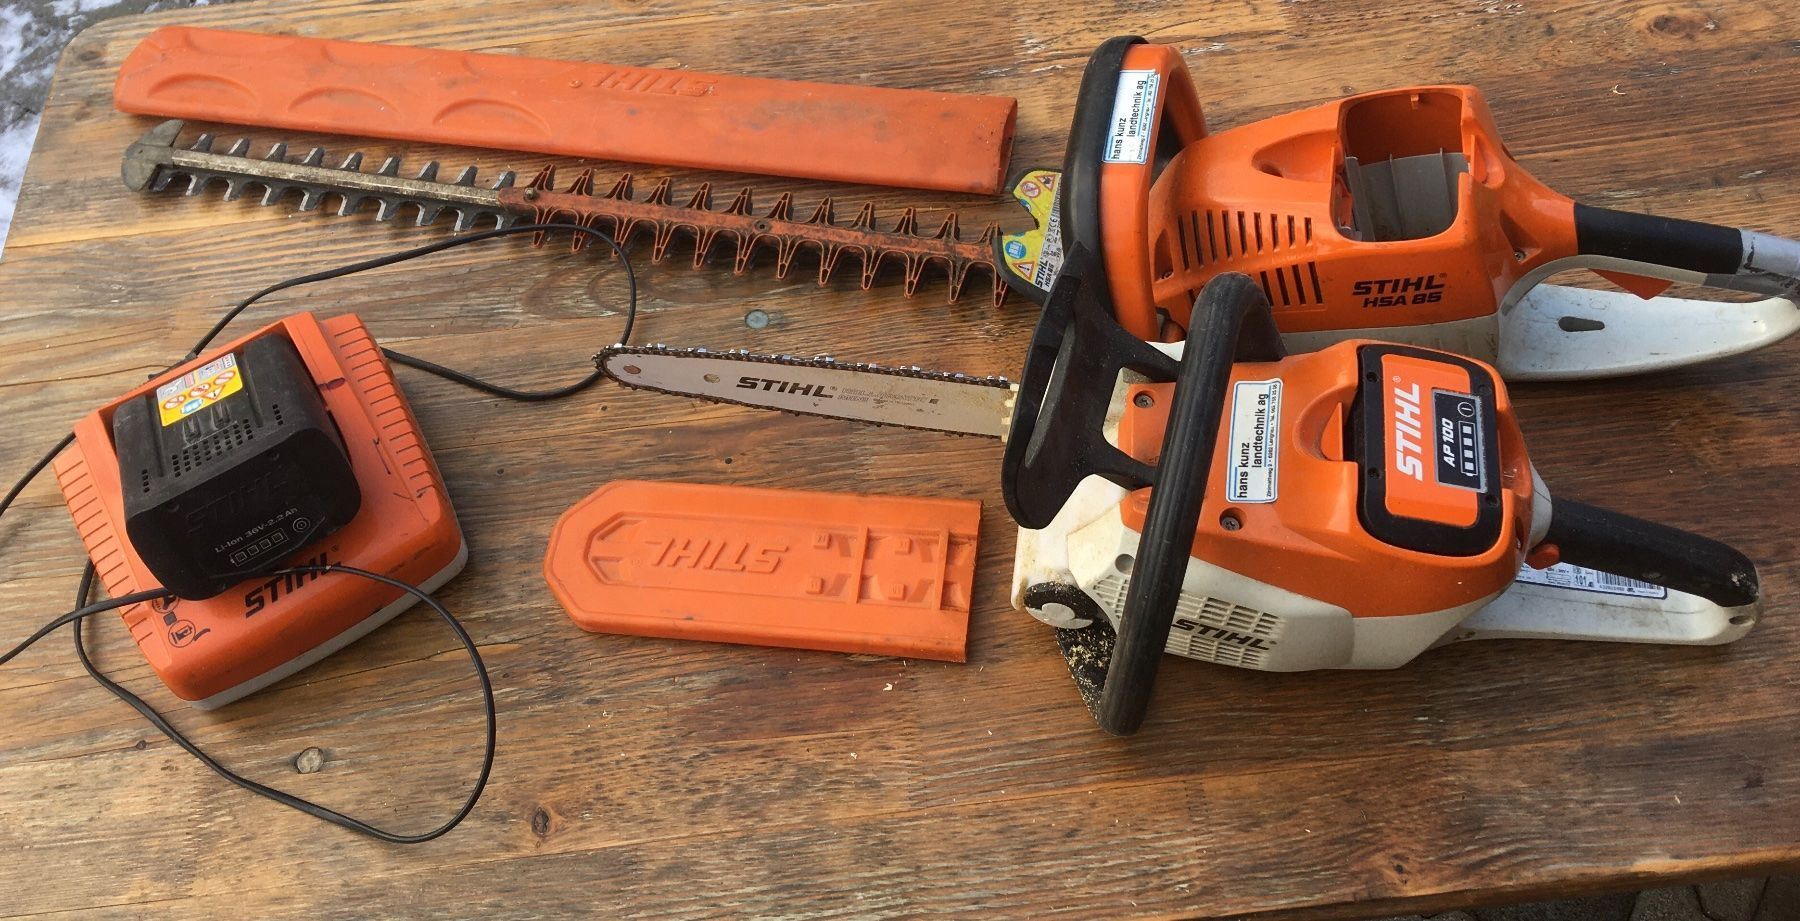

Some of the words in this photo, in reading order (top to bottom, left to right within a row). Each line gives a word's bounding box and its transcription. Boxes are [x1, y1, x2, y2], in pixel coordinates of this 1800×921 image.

[592, 71, 718, 97] STIHL
[1126, 91, 1142, 138] landtechnik
[1135, 80, 1147, 90] ag
[1114, 117, 1127, 137] kunz
[1111, 139, 1123, 160] hans
[1035, 260, 1048, 288] STIHL
[1044, 273, 1053, 288] HSA
[1352, 275, 1445, 296] STIHL
[1362, 296, 1407, 308] HSA
[1412, 291, 1443, 305] 85
[736, 376, 834, 399] STIHL
[1257, 394, 1269, 406] ag
[1251, 408, 1266, 468] landtechnik
[1394, 383, 1423, 482] STIHL
[1441, 418, 1455, 444] 100
[1238, 442, 1250, 468] kunz
[1442, 446, 1456, 468] AP
[1237, 471, 1248, 498] hans
[645, 535, 789, 575] STIHL
[245, 551, 341, 618] STIHL
[1171, 618, 1270, 651] STIHL
